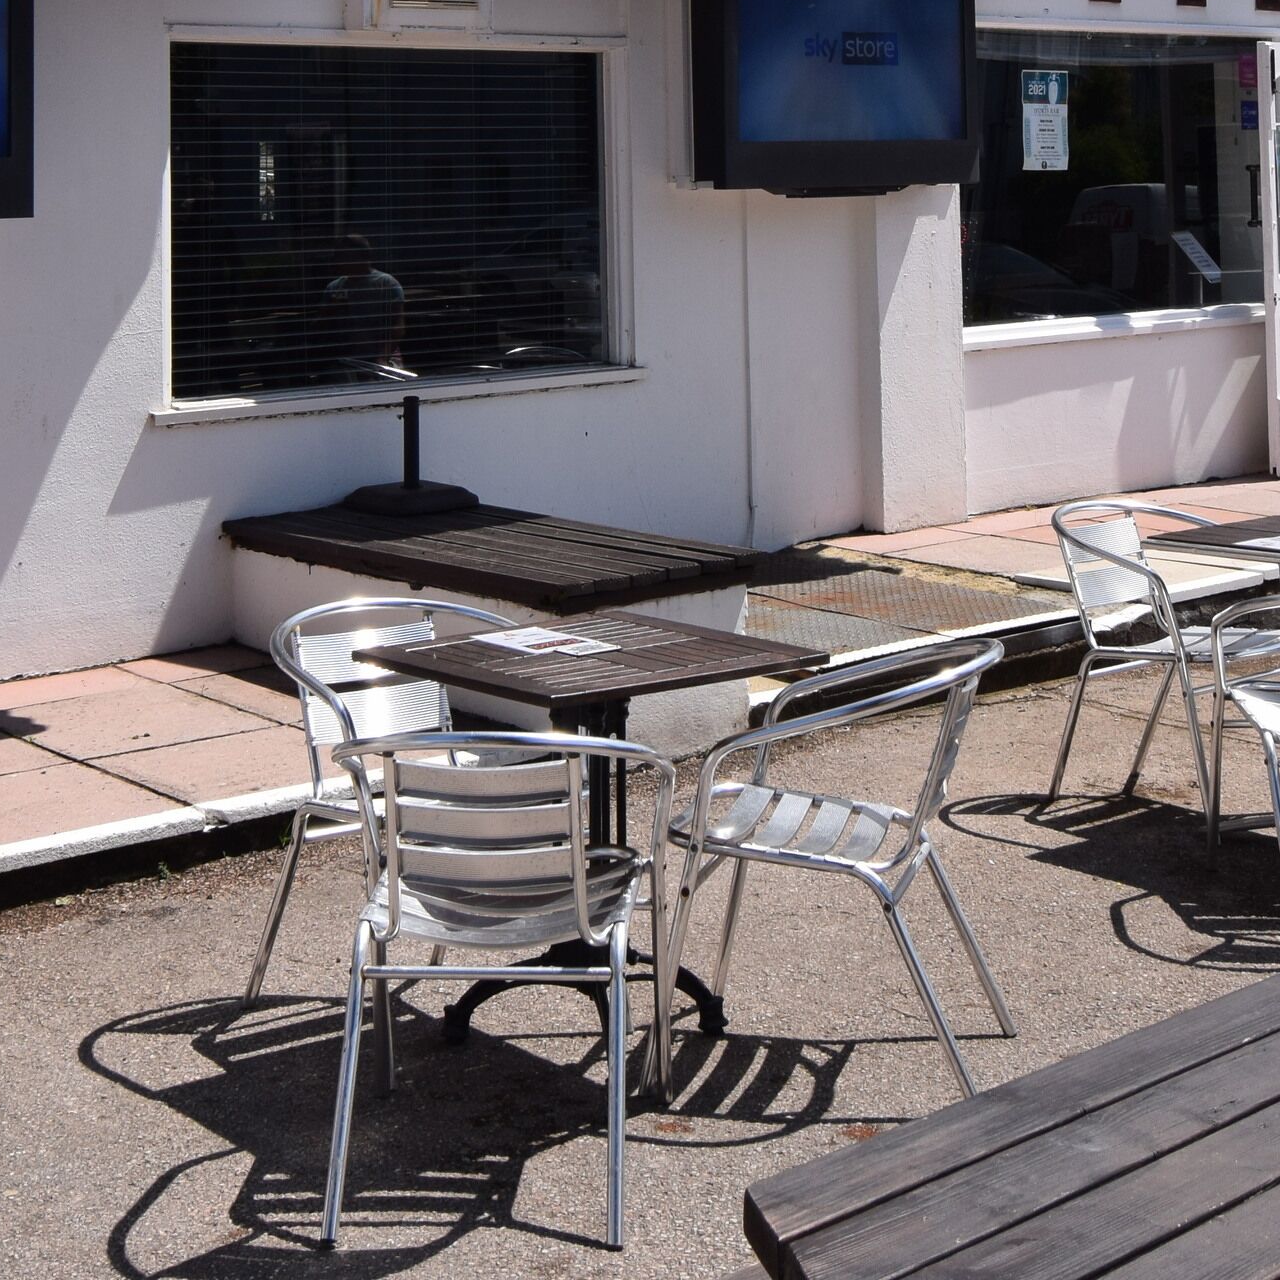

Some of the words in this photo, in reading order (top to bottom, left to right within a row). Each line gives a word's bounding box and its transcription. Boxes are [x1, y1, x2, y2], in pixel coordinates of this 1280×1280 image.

[804, 32, 838, 63] sky
[845, 36, 895, 58] store
[1028, 84, 1046, 95] 2021
